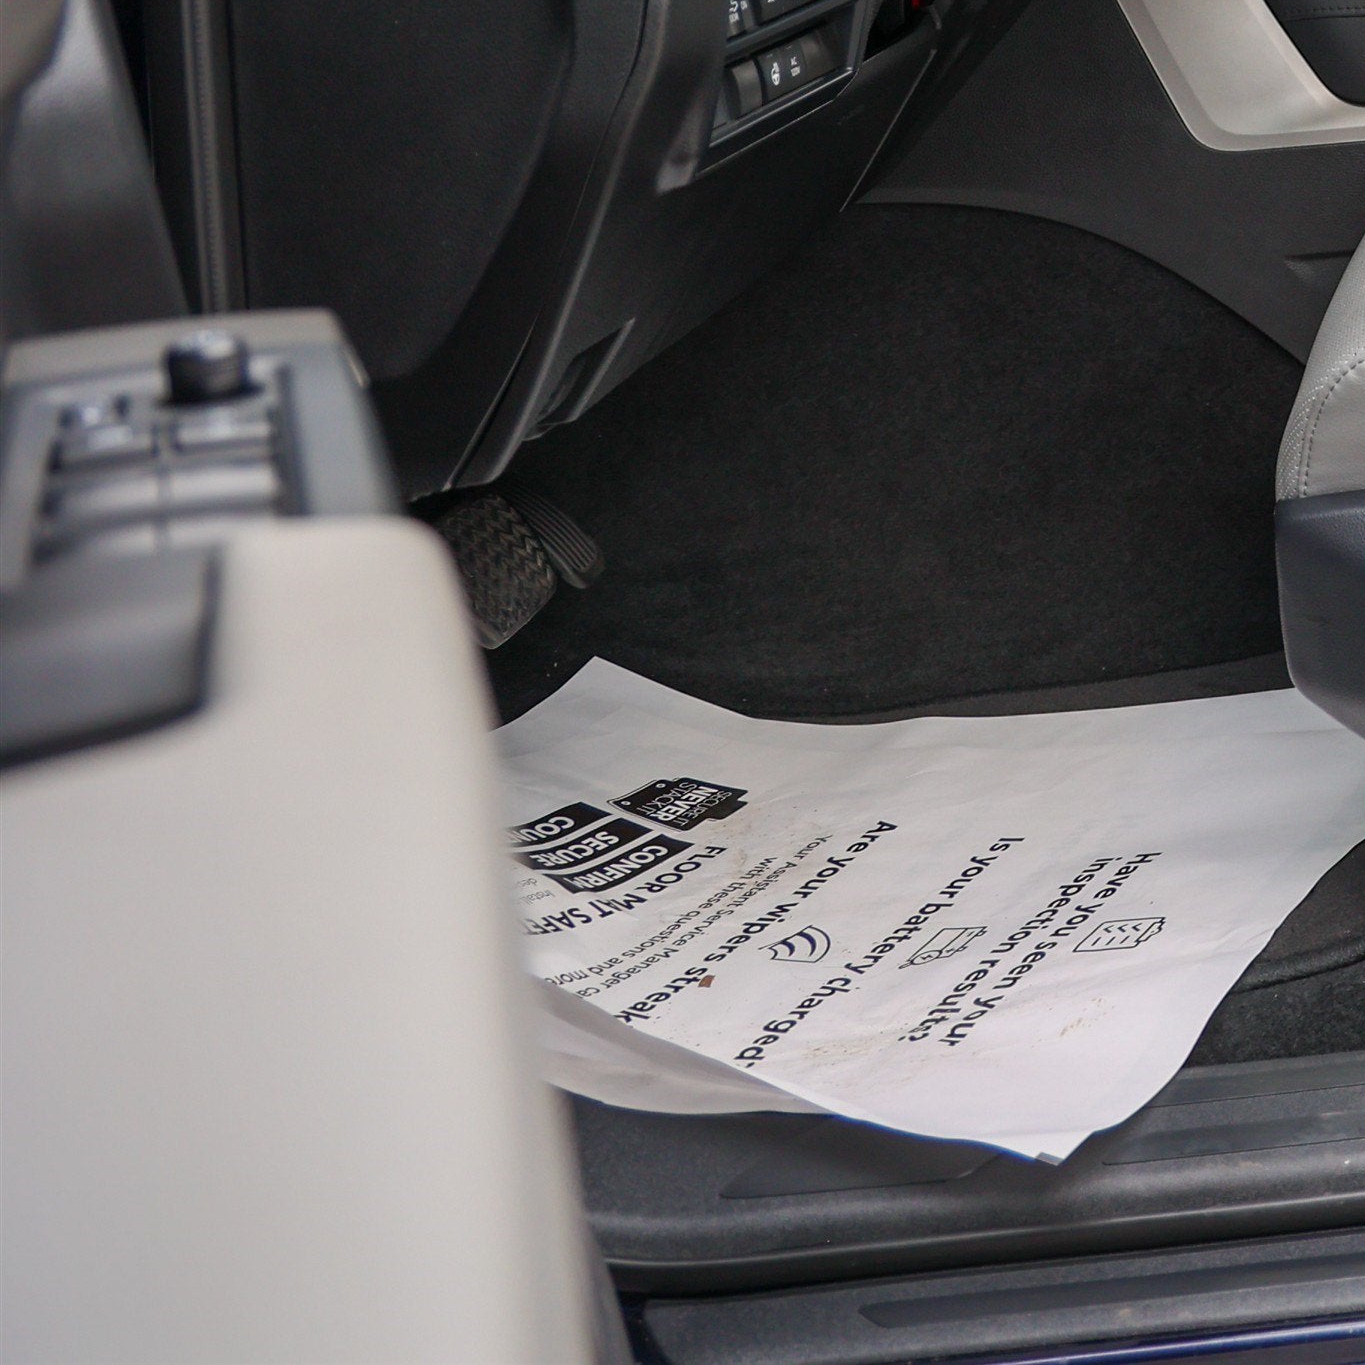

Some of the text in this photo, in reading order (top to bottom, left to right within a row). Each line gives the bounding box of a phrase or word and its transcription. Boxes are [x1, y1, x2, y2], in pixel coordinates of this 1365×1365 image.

[636, 782, 698, 815] STACK IT
[649, 786, 719, 822] NEVER
[673, 790, 733, 827] SECURE IT
[508, 816, 575, 845] COUN
[529, 831, 620, 867] SECURE
[794, 835, 833, 860] Your
[846, 819, 898, 854] Are
[989, 836, 1025, 853] Is
[563, 845, 669, 889] CONFIRM
[634, 845, 728, 893] FLOOR
[727, 861, 797, 907] Assistant
[740, 857, 778, 880] with
[792, 855, 856, 899] your
[938, 855, 1000, 899] your
[588, 893, 648, 918] MAT
[699, 882, 747, 909] these
[622, 910, 701, 957] questions
[672, 909, 734, 947] Service
[704, 902, 800, 962] wipers
[844, 901, 954, 975] battery
[587, 957, 623, 976] and
[898, 857, 1113, 1042] inspection results?
[938, 851, 1162, 1046] Have you seen your
[604, 947, 680, 989] Manager
